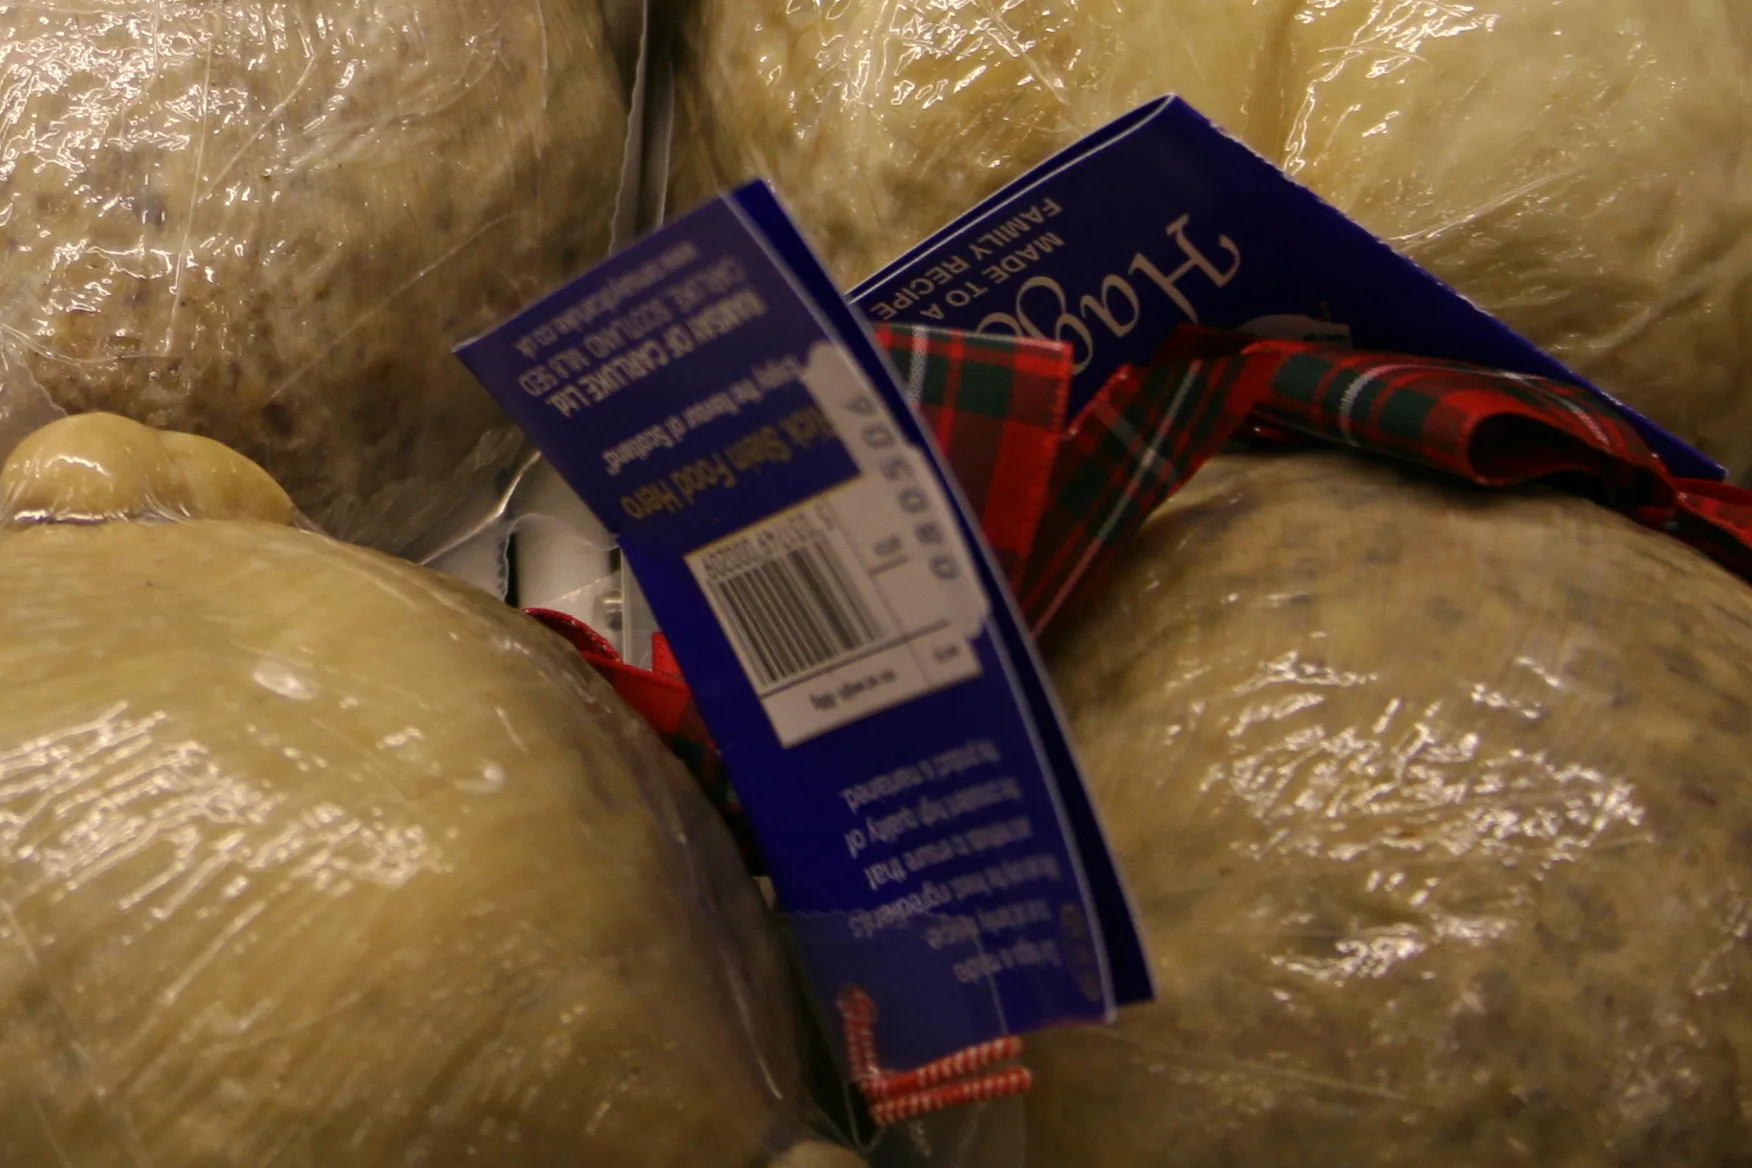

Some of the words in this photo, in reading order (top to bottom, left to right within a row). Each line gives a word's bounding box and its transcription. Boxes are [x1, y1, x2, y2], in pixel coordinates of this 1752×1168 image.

[969, 195, 1061, 261] FAMILY
[981, 228, 1064, 285] MADE
[867, 253, 968, 323] RECIPE
[918, 298, 943, 321] A
[942, 276, 986, 311] TO
[683, 284, 770, 346] RAMSAY
[662, 320, 697, 360] OF
[575, 335, 671, 405] CARLUKE
[544, 382, 590, 420] Ltd.
[663, 412, 690, 444] of
[721, 423, 795, 477] Stein
[667, 449, 738, 507] Food
[620, 477, 684, 523] Hero
[842, 825, 868, 859] of
[865, 807, 920, 844] quality
[862, 854, 908, 892] that
